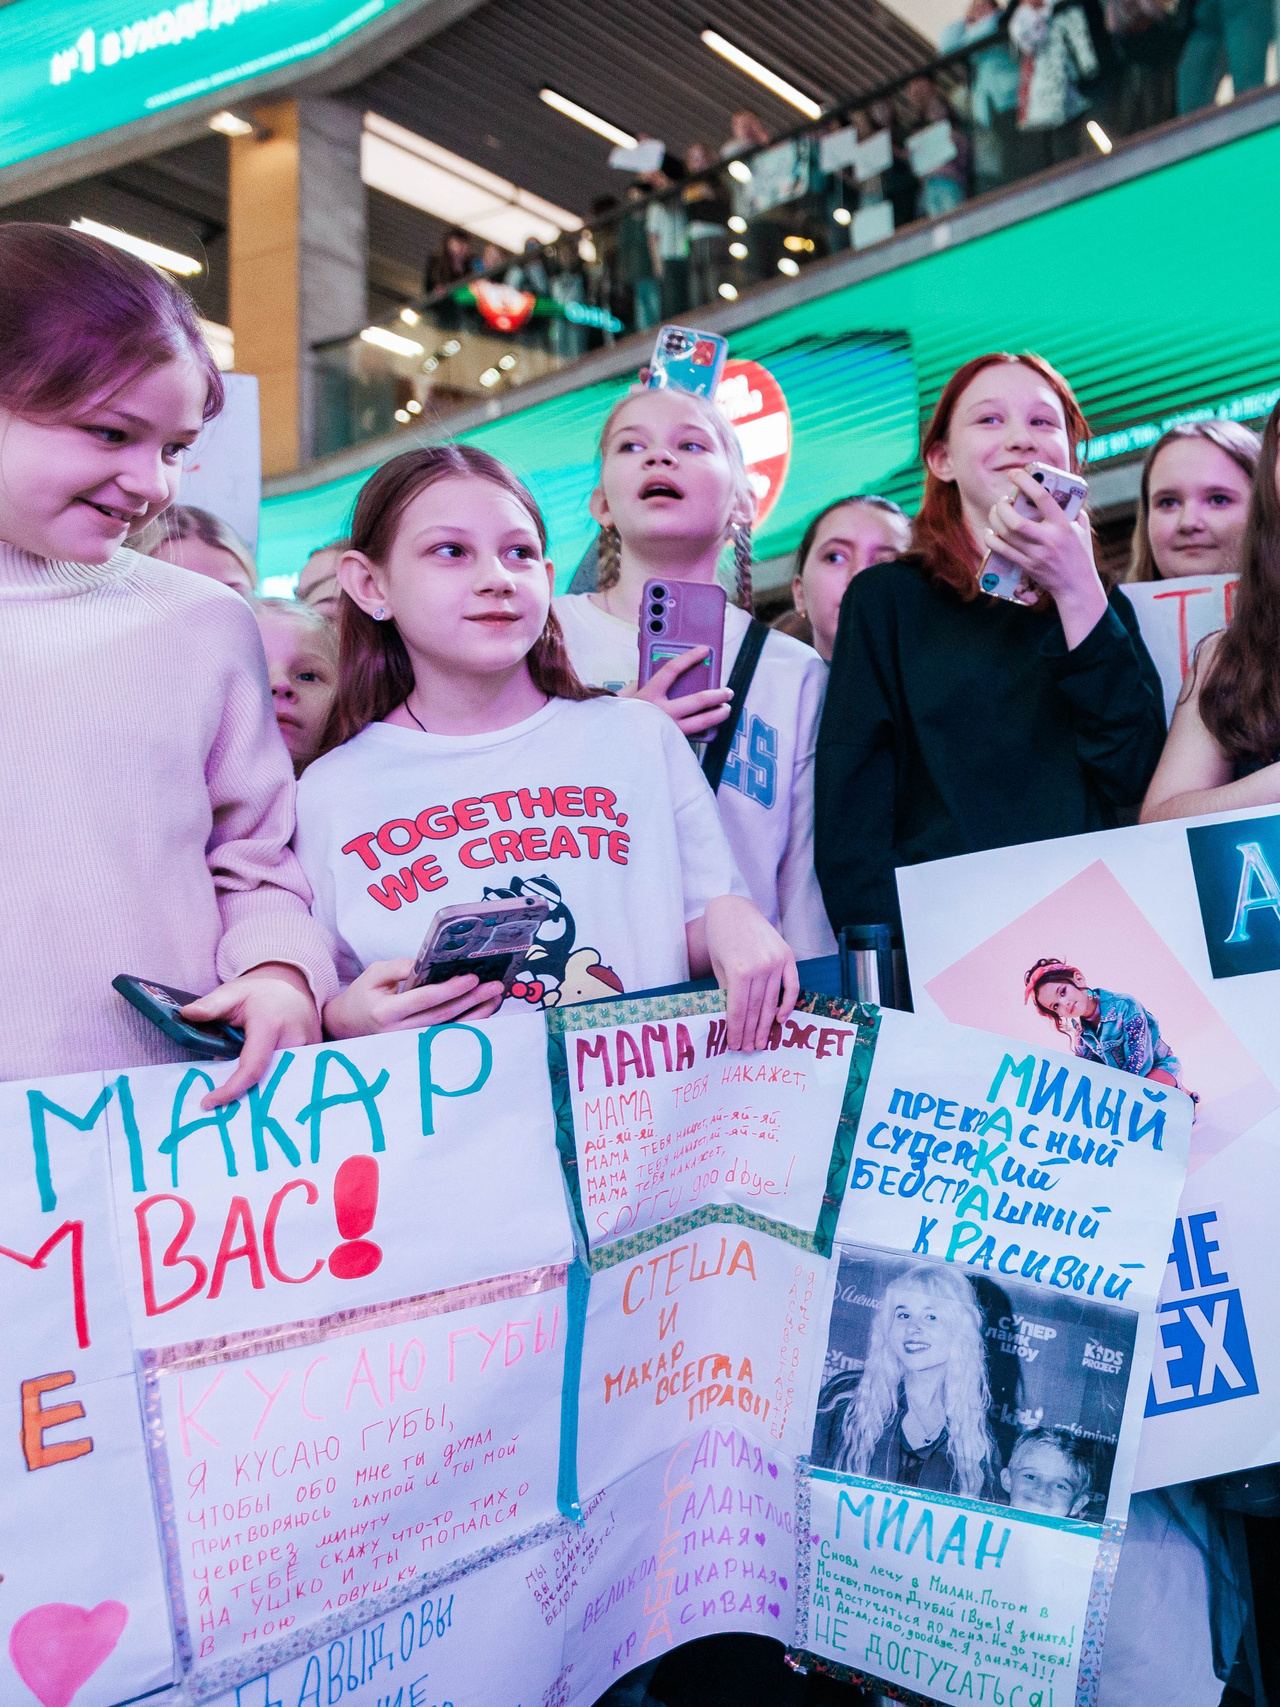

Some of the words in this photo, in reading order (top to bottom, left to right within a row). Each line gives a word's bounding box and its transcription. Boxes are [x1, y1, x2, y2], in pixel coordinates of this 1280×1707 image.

[341, 785, 629, 871] TOGETHER,
[367, 854, 449, 912] WE
[458, 826, 631, 870] CREATE
[577, 1022, 695, 1092] МАМА
[27, 1022, 493, 1213] МАКАР
[584, 1089, 654, 1133] МАМА
[888, 1088, 1125, 1168] ПРЕКРАСНЫЙ
[986, 1053, 1168, 1151] МИЛЫЙ
[586, 1150, 630, 1173] МАМА
[640, 1133, 672, 1157] ТЕБЯ
[586, 1169, 628, 1193] МАМА
[636, 1153, 669, 1178] ТЕБЯ
[134, 1154, 384, 1317] ВАС!
[588, 1186, 629, 1208] МАМА
[622, 1237, 757, 1316] СТЕША
[658, 1301, 679, 1341] И
[177, 1337, 427, 1459] КУСАЮ
[448, 1304, 560, 1384] ГУБЫ
[603, 1339, 685, 1405] МАКАР
[687, 1383, 771, 1422] ПРАВЫ
[188, 1459, 208, 1499] Я
[234, 1436, 341, 1488] КУСАЮ
[361, 1403, 455, 1452] ГУБЫ,
[188, 1492, 271, 1530] ЧТОБЫ
[296, 1476, 337, 1503] ОБО
[402, 1452, 426, 1473] ТЫ
[191, 1505, 332, 1560] ПРИТВОРЯЮСЬ
[452, 1457, 475, 1476] ТЫ
[483, 1433, 521, 1468] МОЙ
[835, 1489, 1012, 1570] МИЛАН
[198, 1586, 212, 1608] Я
[230, 1561, 299, 1599] ТЕБЕ
[320, 1537, 381, 1571] СКАЖУ
[392, 1509, 454, 1545] ЧТО-ТО
[200, 1611, 231, 1634] НА
[252, 1577, 324, 1616] УШКО
[341, 1567, 355, 1583] И
[372, 1548, 399, 1572] ТЫ
[421, 1503, 518, 1552] ПОПАЛСЯ
[315, 1512, 391, 1549] МИНУТУ
[815, 1577, 831, 1593] Не
[199, 1634, 215, 1659] В
[241, 1613, 297, 1645] МОЮ
[815, 1613, 849, 1652] НЕ
